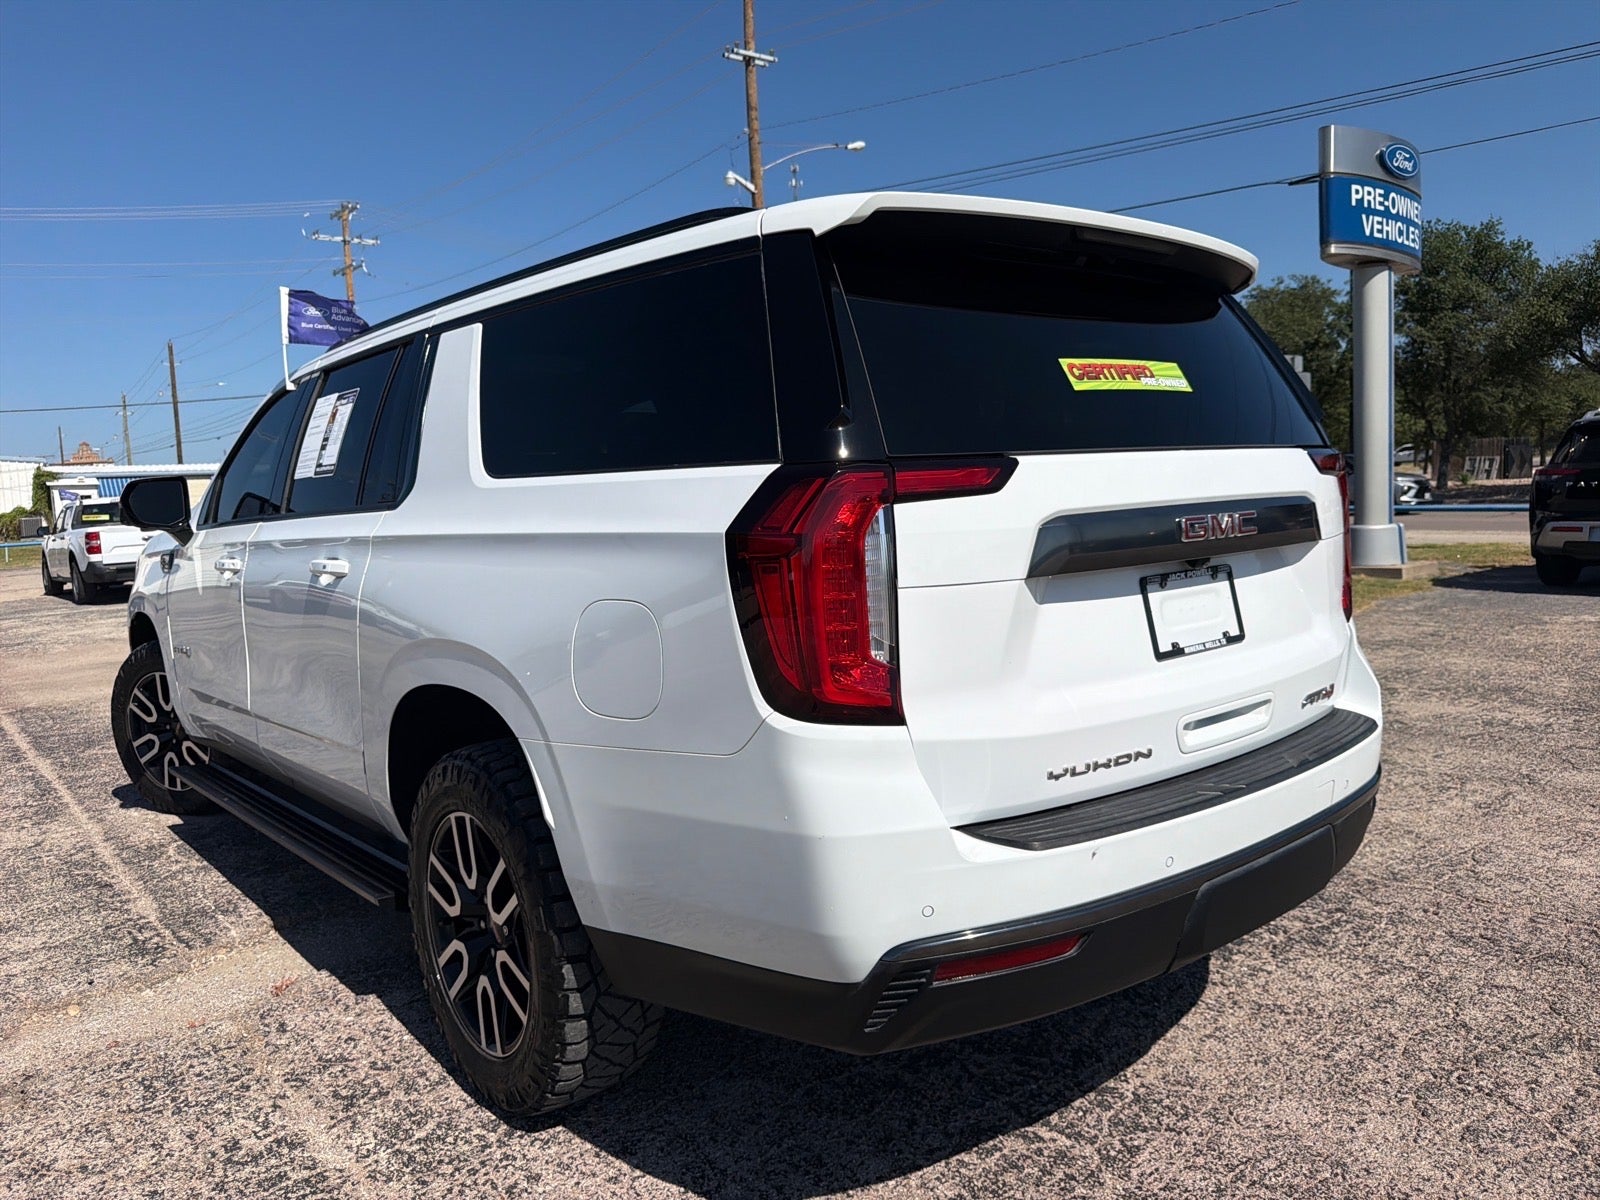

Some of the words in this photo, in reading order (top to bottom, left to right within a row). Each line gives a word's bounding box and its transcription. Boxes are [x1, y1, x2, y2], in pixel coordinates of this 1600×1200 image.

[1393, 150, 1414, 172] Ford
[1351, 184, 1422, 225] PRE-OWNE
[1362, 213, 1420, 251] VEHICLES
[1066, 362, 1156, 381] CERTIFIED
[1140, 377, 1187, 388] PRE-OWNED
[1181, 510, 1258, 542] GMC
[1168, 572, 1186, 581] JACK
[1187, 568, 1213, 580] POWELL
[1047, 748, 1153, 781] YUKON
